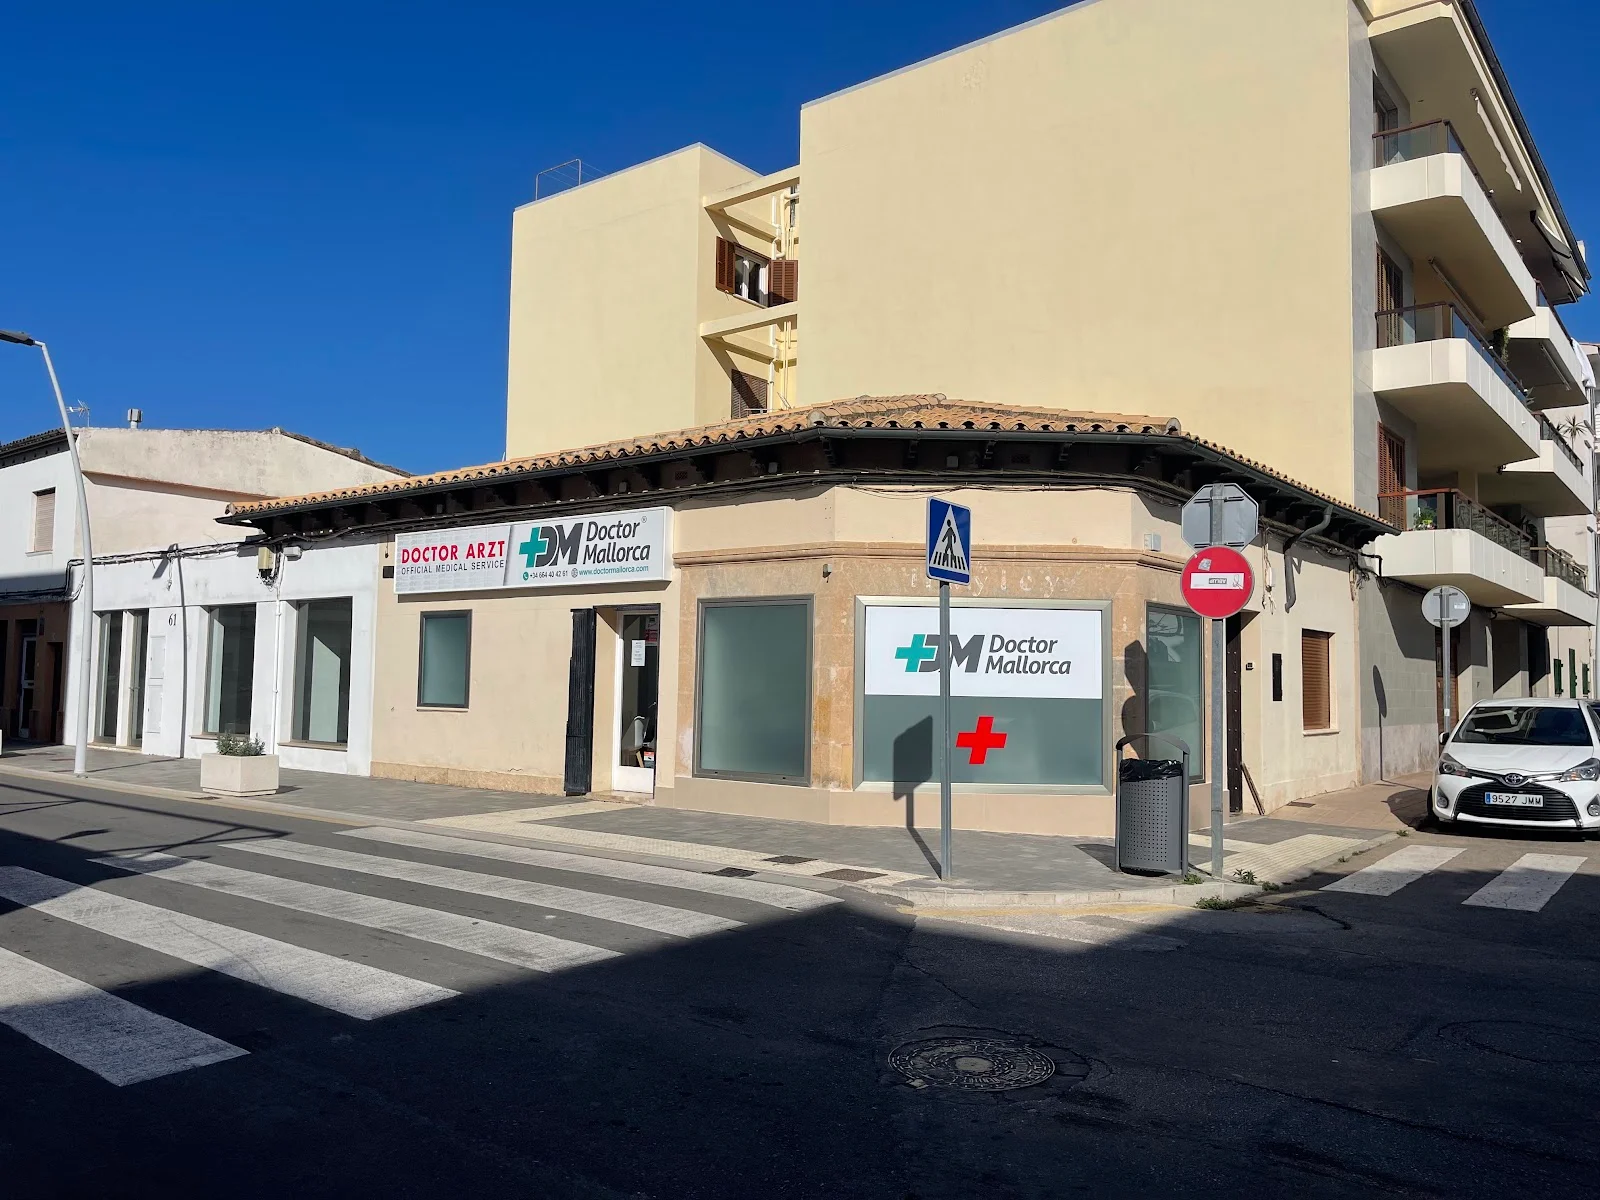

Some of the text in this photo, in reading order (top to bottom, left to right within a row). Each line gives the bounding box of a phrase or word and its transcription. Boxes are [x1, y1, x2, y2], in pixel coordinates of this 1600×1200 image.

[586, 520, 640, 541] Doctor
[401, 541, 505, 564] DOCTOR ARZT
[583, 542, 651, 564] Mallorca
[401, 559, 505, 575] OFFICIAL MEDICAL SERVICE
[579, 565, 649, 576] www.doctormallorca.com
[168, 612, 177, 626] 61
[989, 634, 1058, 654] Doctor
[985, 655, 1072, 674] Mallorca
[1492, 794, 1542, 806] 9527 JMM
